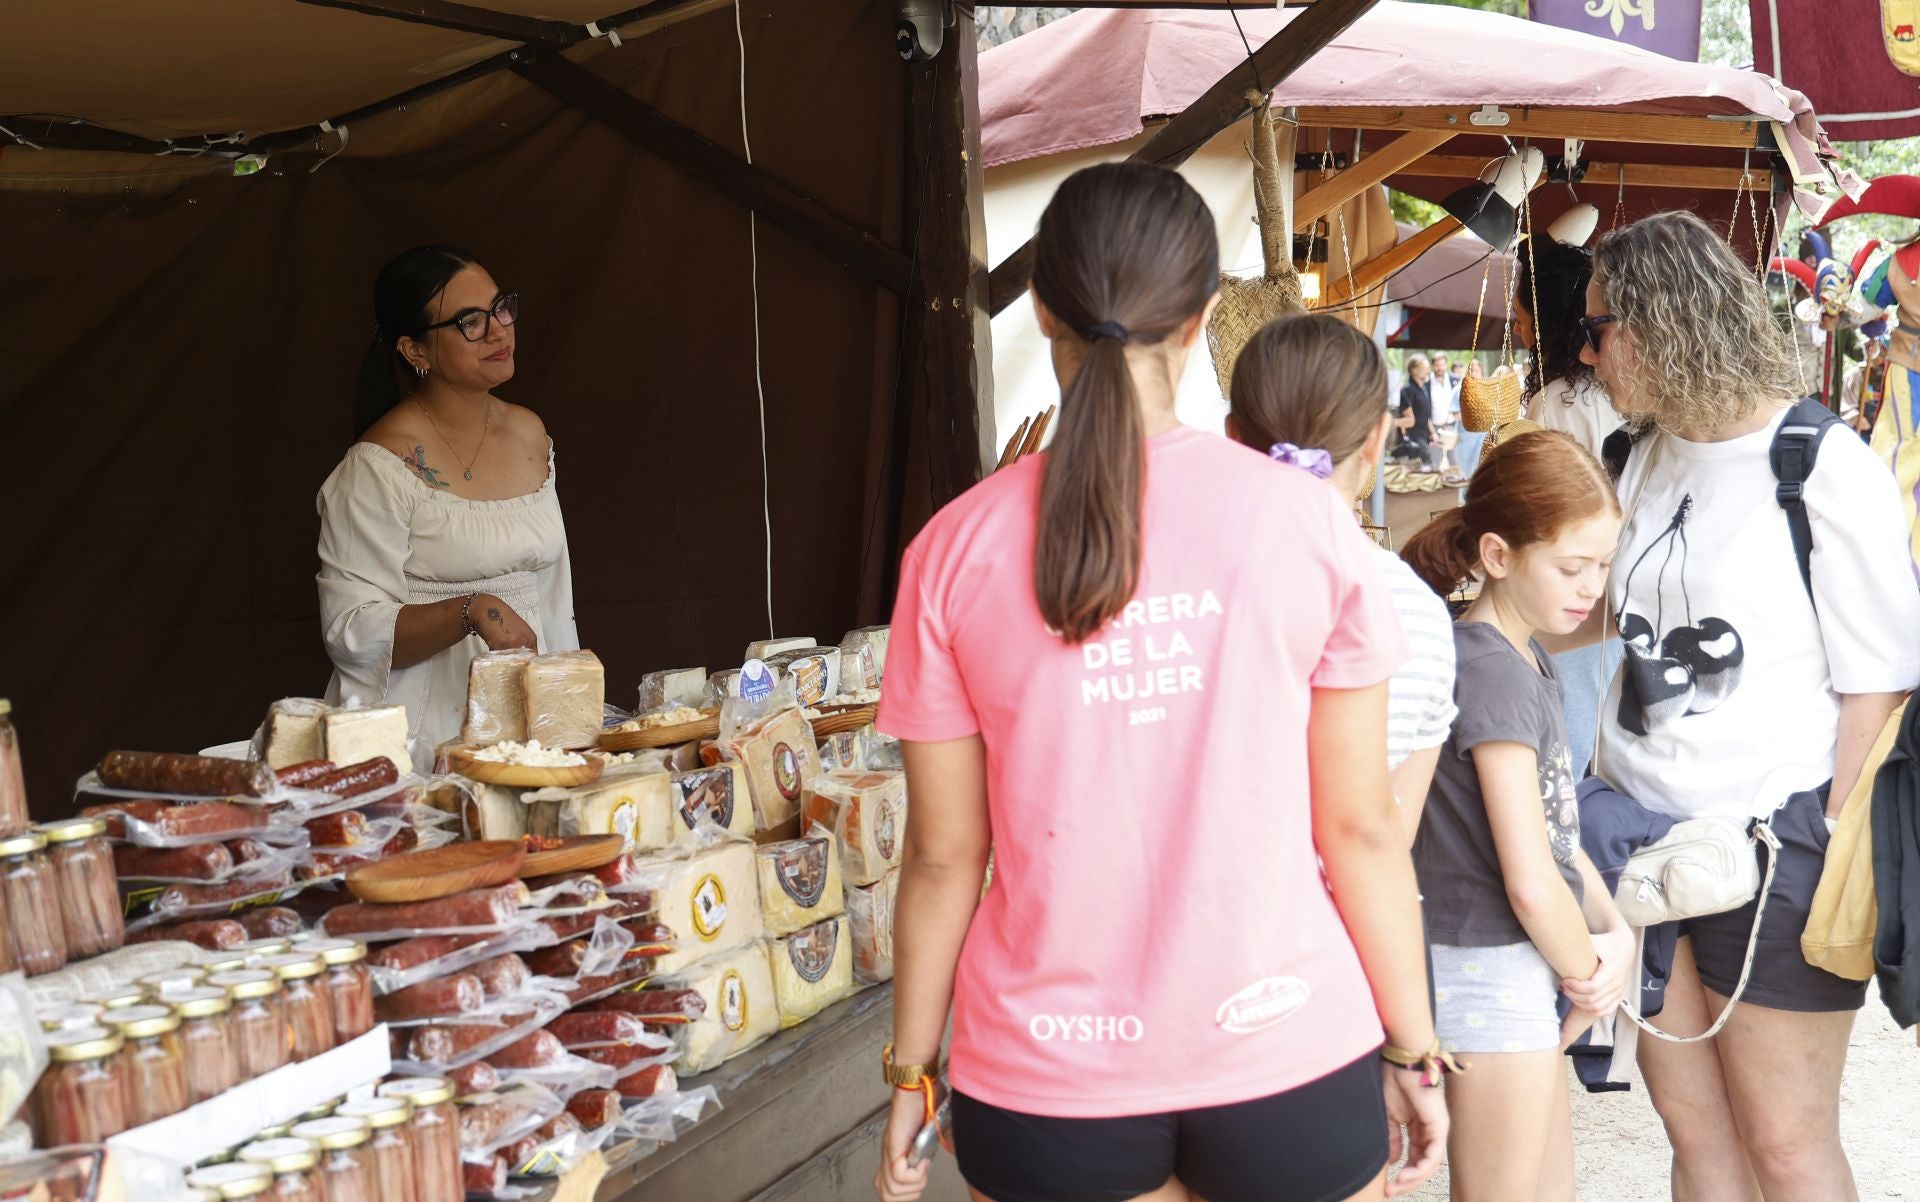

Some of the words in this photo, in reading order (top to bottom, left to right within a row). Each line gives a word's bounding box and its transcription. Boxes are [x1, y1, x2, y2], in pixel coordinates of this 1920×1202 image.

[1111, 590, 1223, 628] RERA
[1083, 640, 1133, 669] DE
[1146, 631, 1193, 660] LA
[1082, 665, 1203, 705] MUJER
[1129, 708, 1166, 725] 2021
[1029, 1014, 1144, 1042] OYSHO
